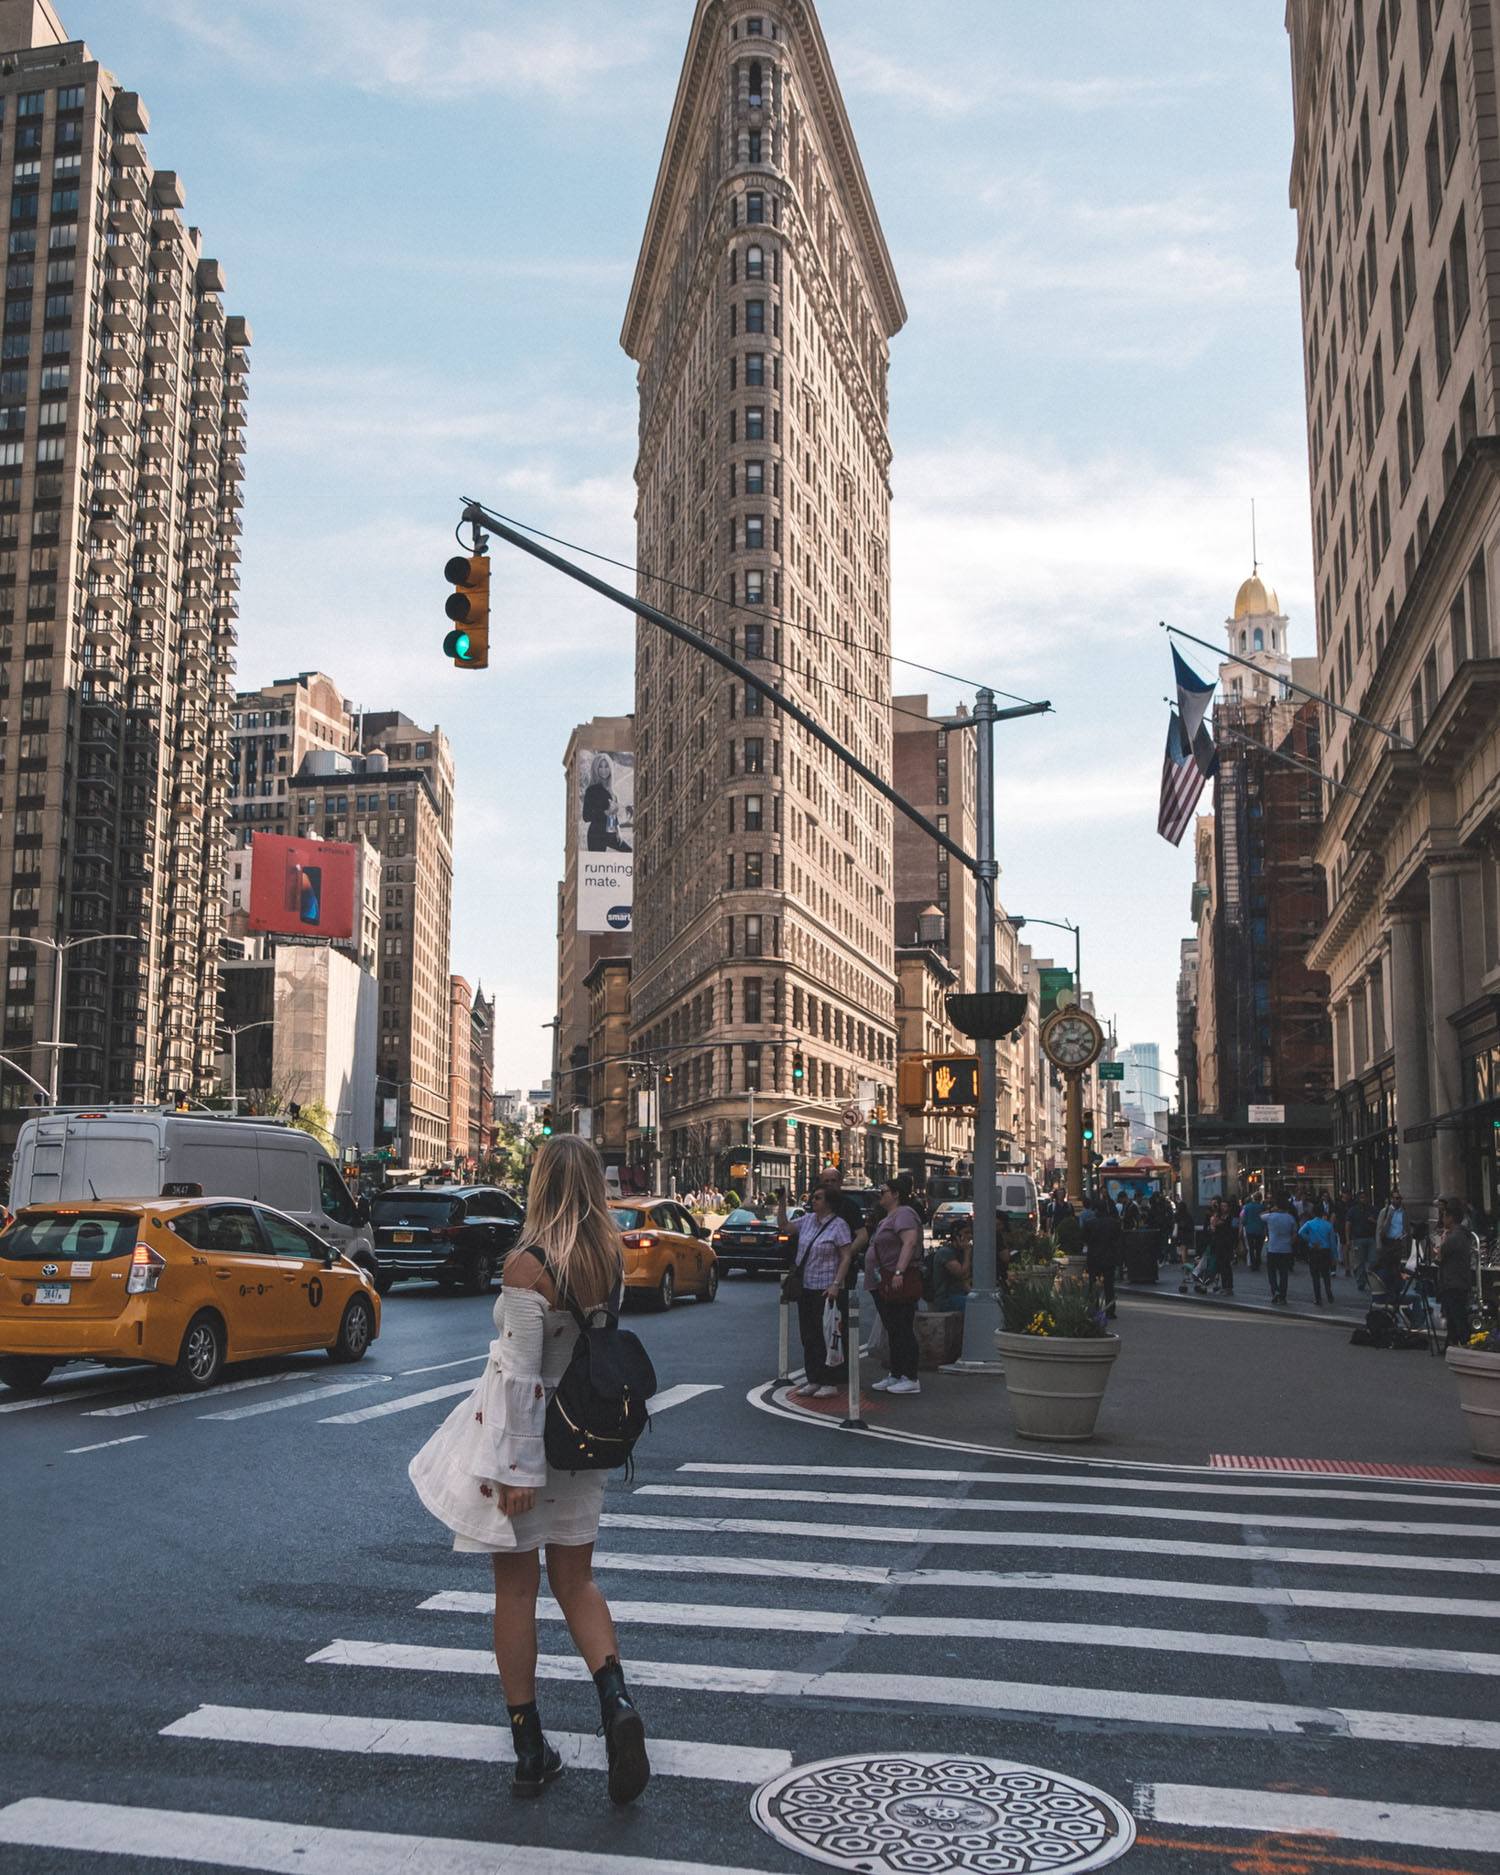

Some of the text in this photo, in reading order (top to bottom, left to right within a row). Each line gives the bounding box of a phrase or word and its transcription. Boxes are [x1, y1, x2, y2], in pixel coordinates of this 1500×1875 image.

[585, 862, 633, 877] running
[585, 877, 620, 887] mate.
[311, 1283, 320, 1304] T
